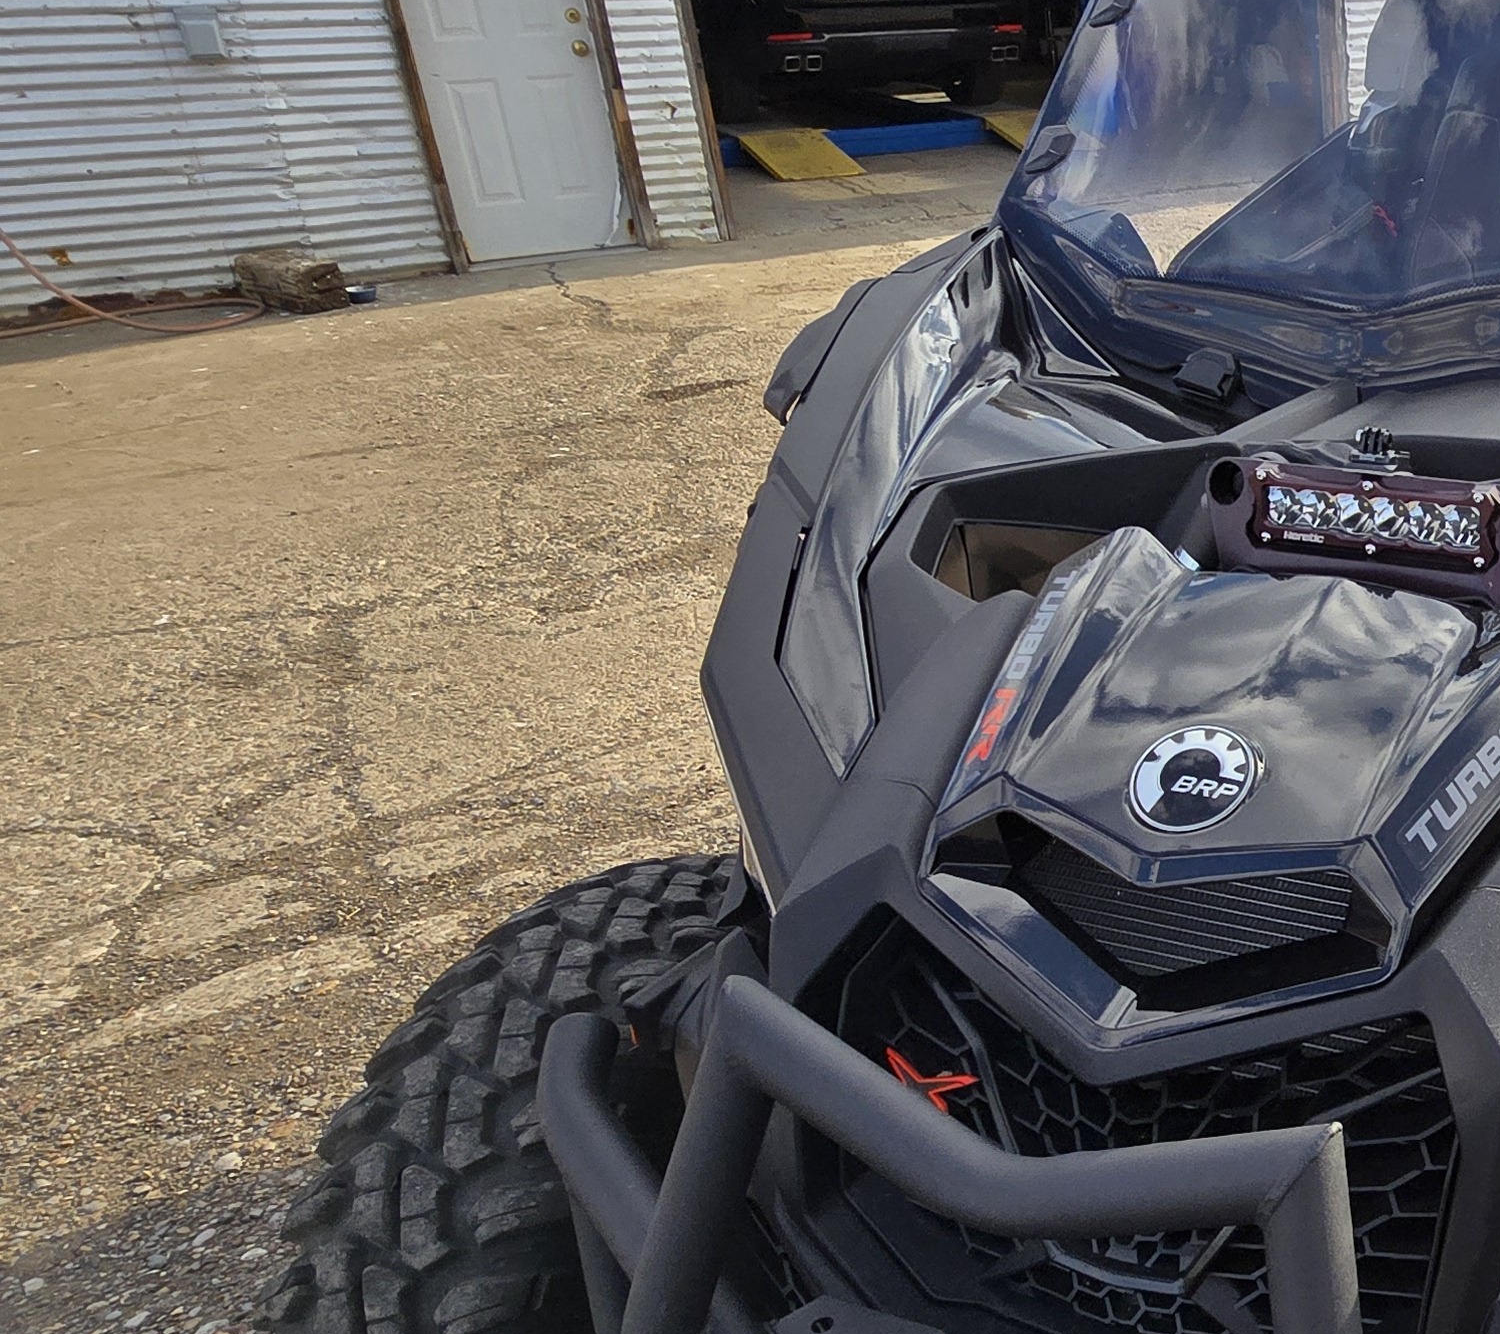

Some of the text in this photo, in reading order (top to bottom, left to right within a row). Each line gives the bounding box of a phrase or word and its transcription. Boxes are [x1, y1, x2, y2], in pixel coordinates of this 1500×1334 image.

[1283, 530, 1325, 544] Heretic
[1006, 570, 1079, 680] TURBO
[1170, 775, 1240, 800] BRP
